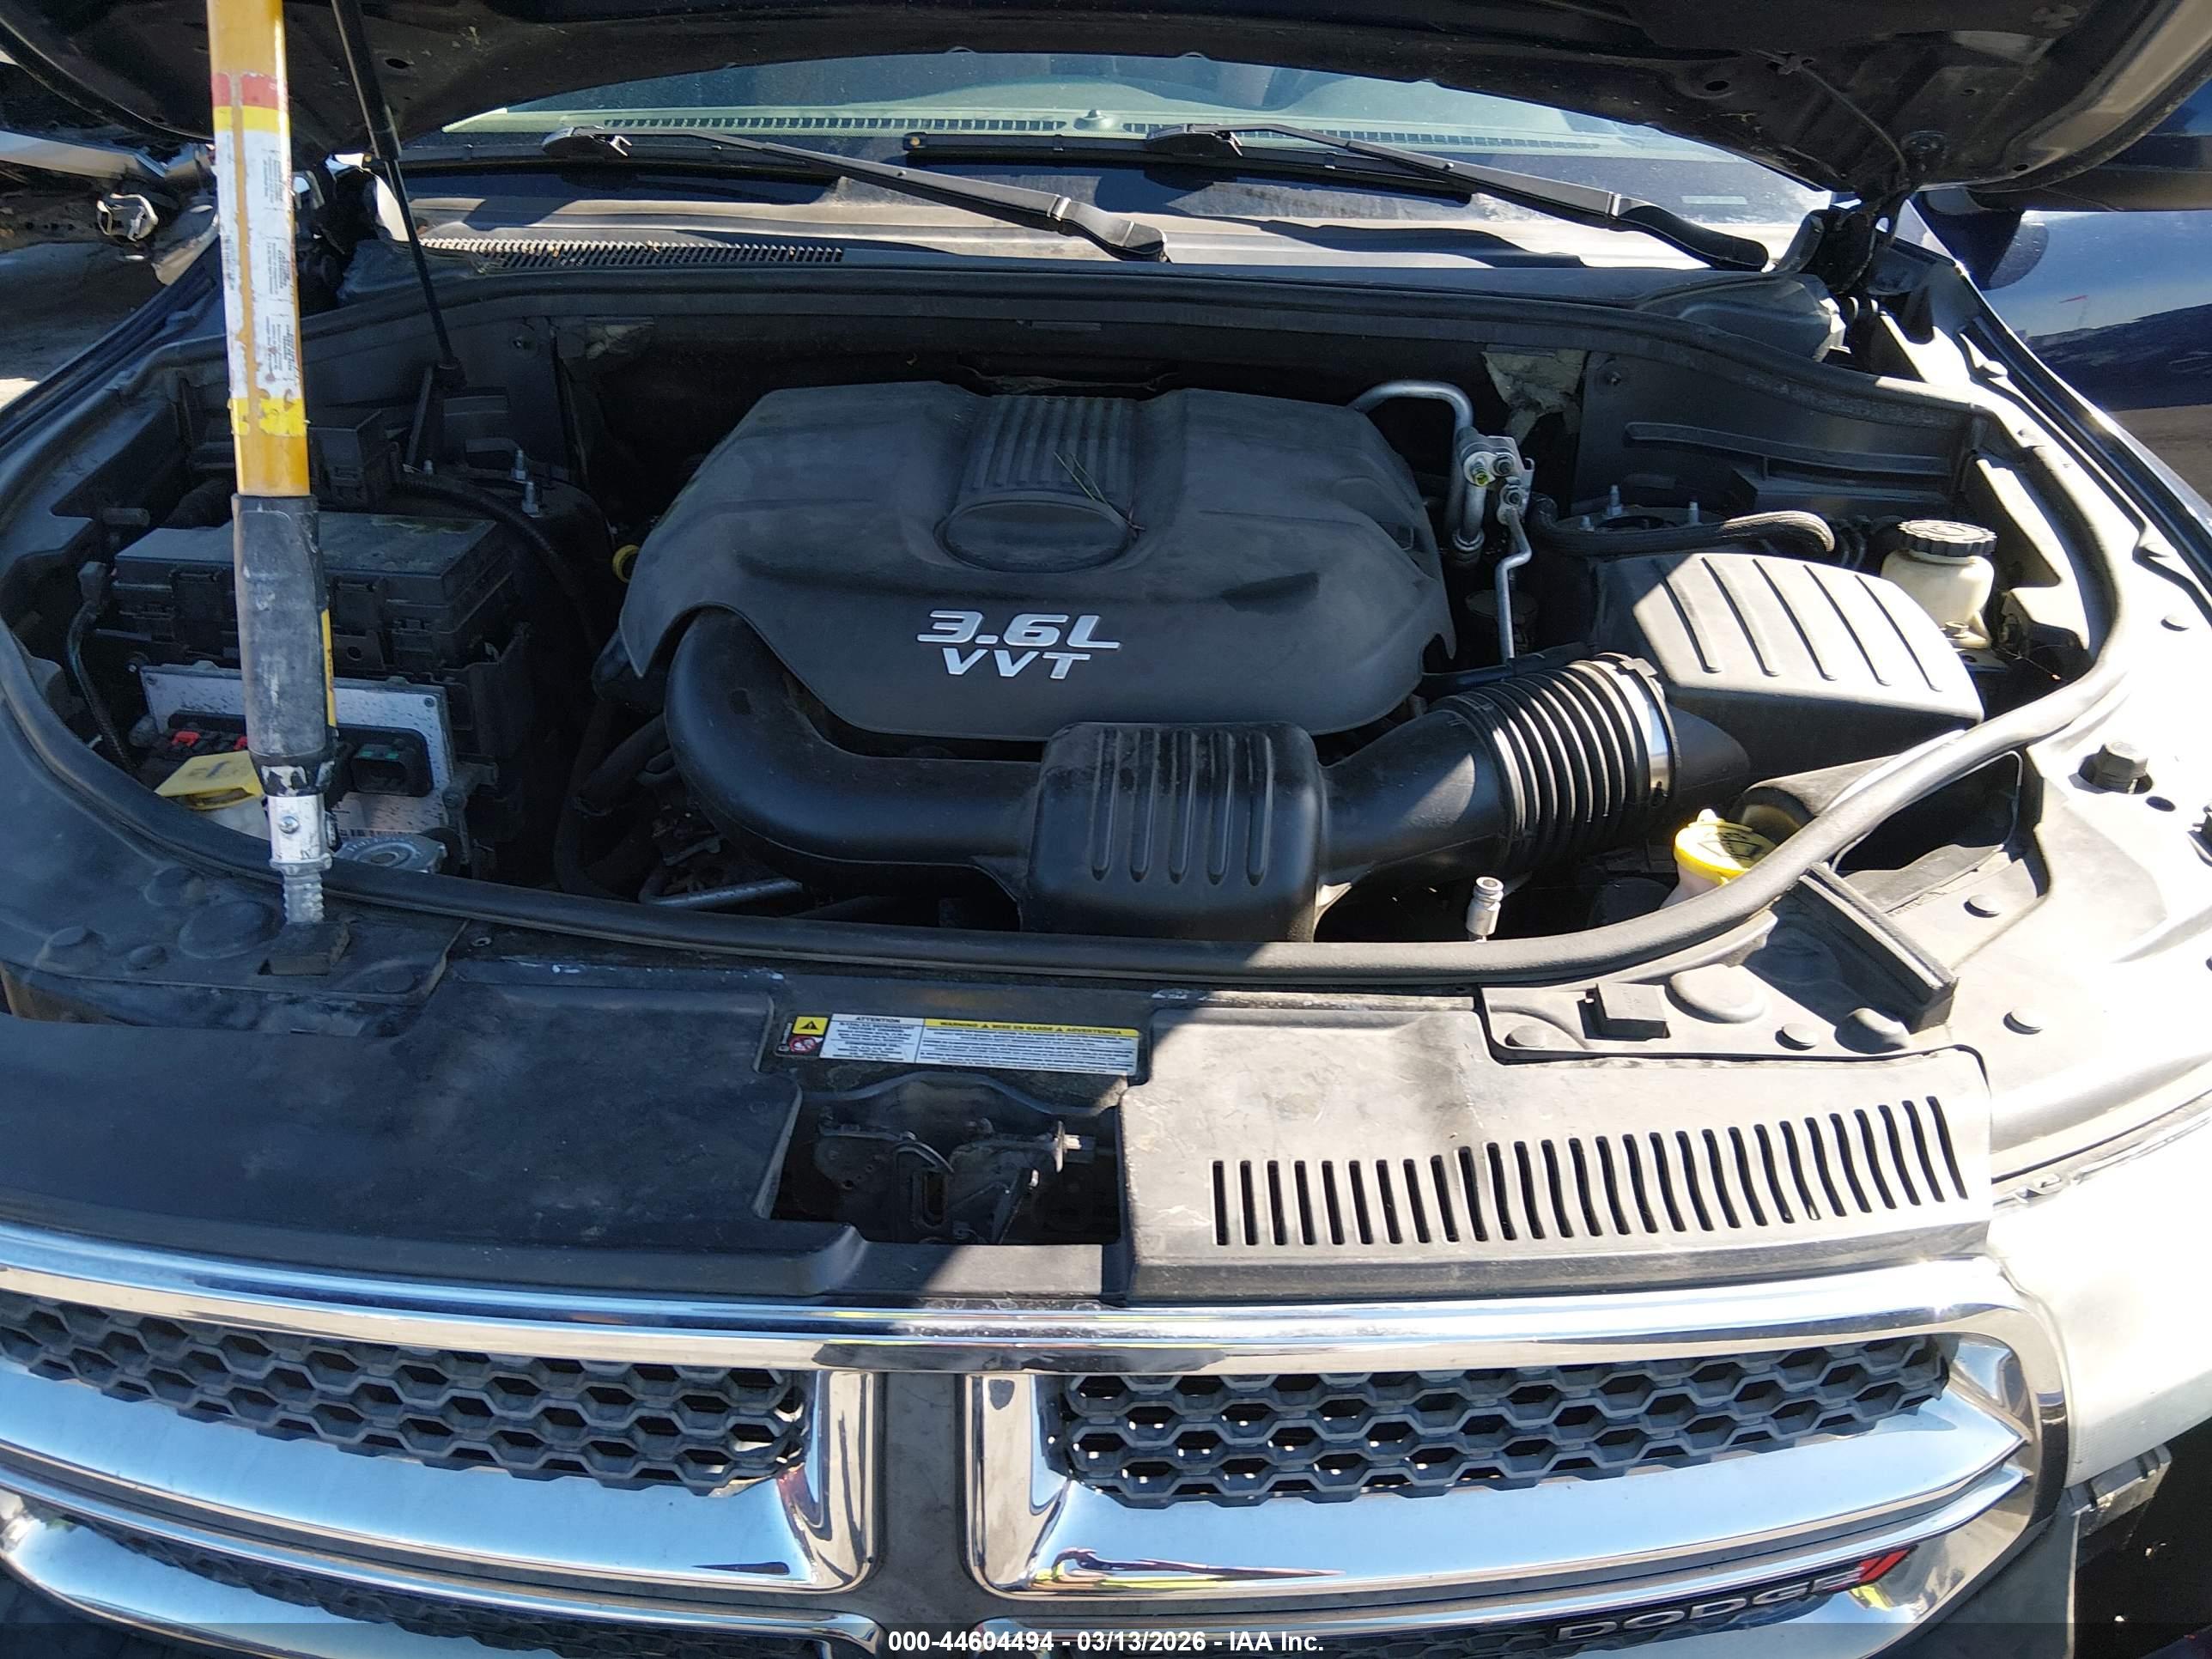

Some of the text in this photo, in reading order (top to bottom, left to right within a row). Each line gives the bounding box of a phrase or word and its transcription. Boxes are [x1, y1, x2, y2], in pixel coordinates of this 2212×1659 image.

[916, 611, 1121, 649] 3.6L
[942, 647, 1091, 680] VVT
[1557, 1565, 1867, 1642] DODGE
